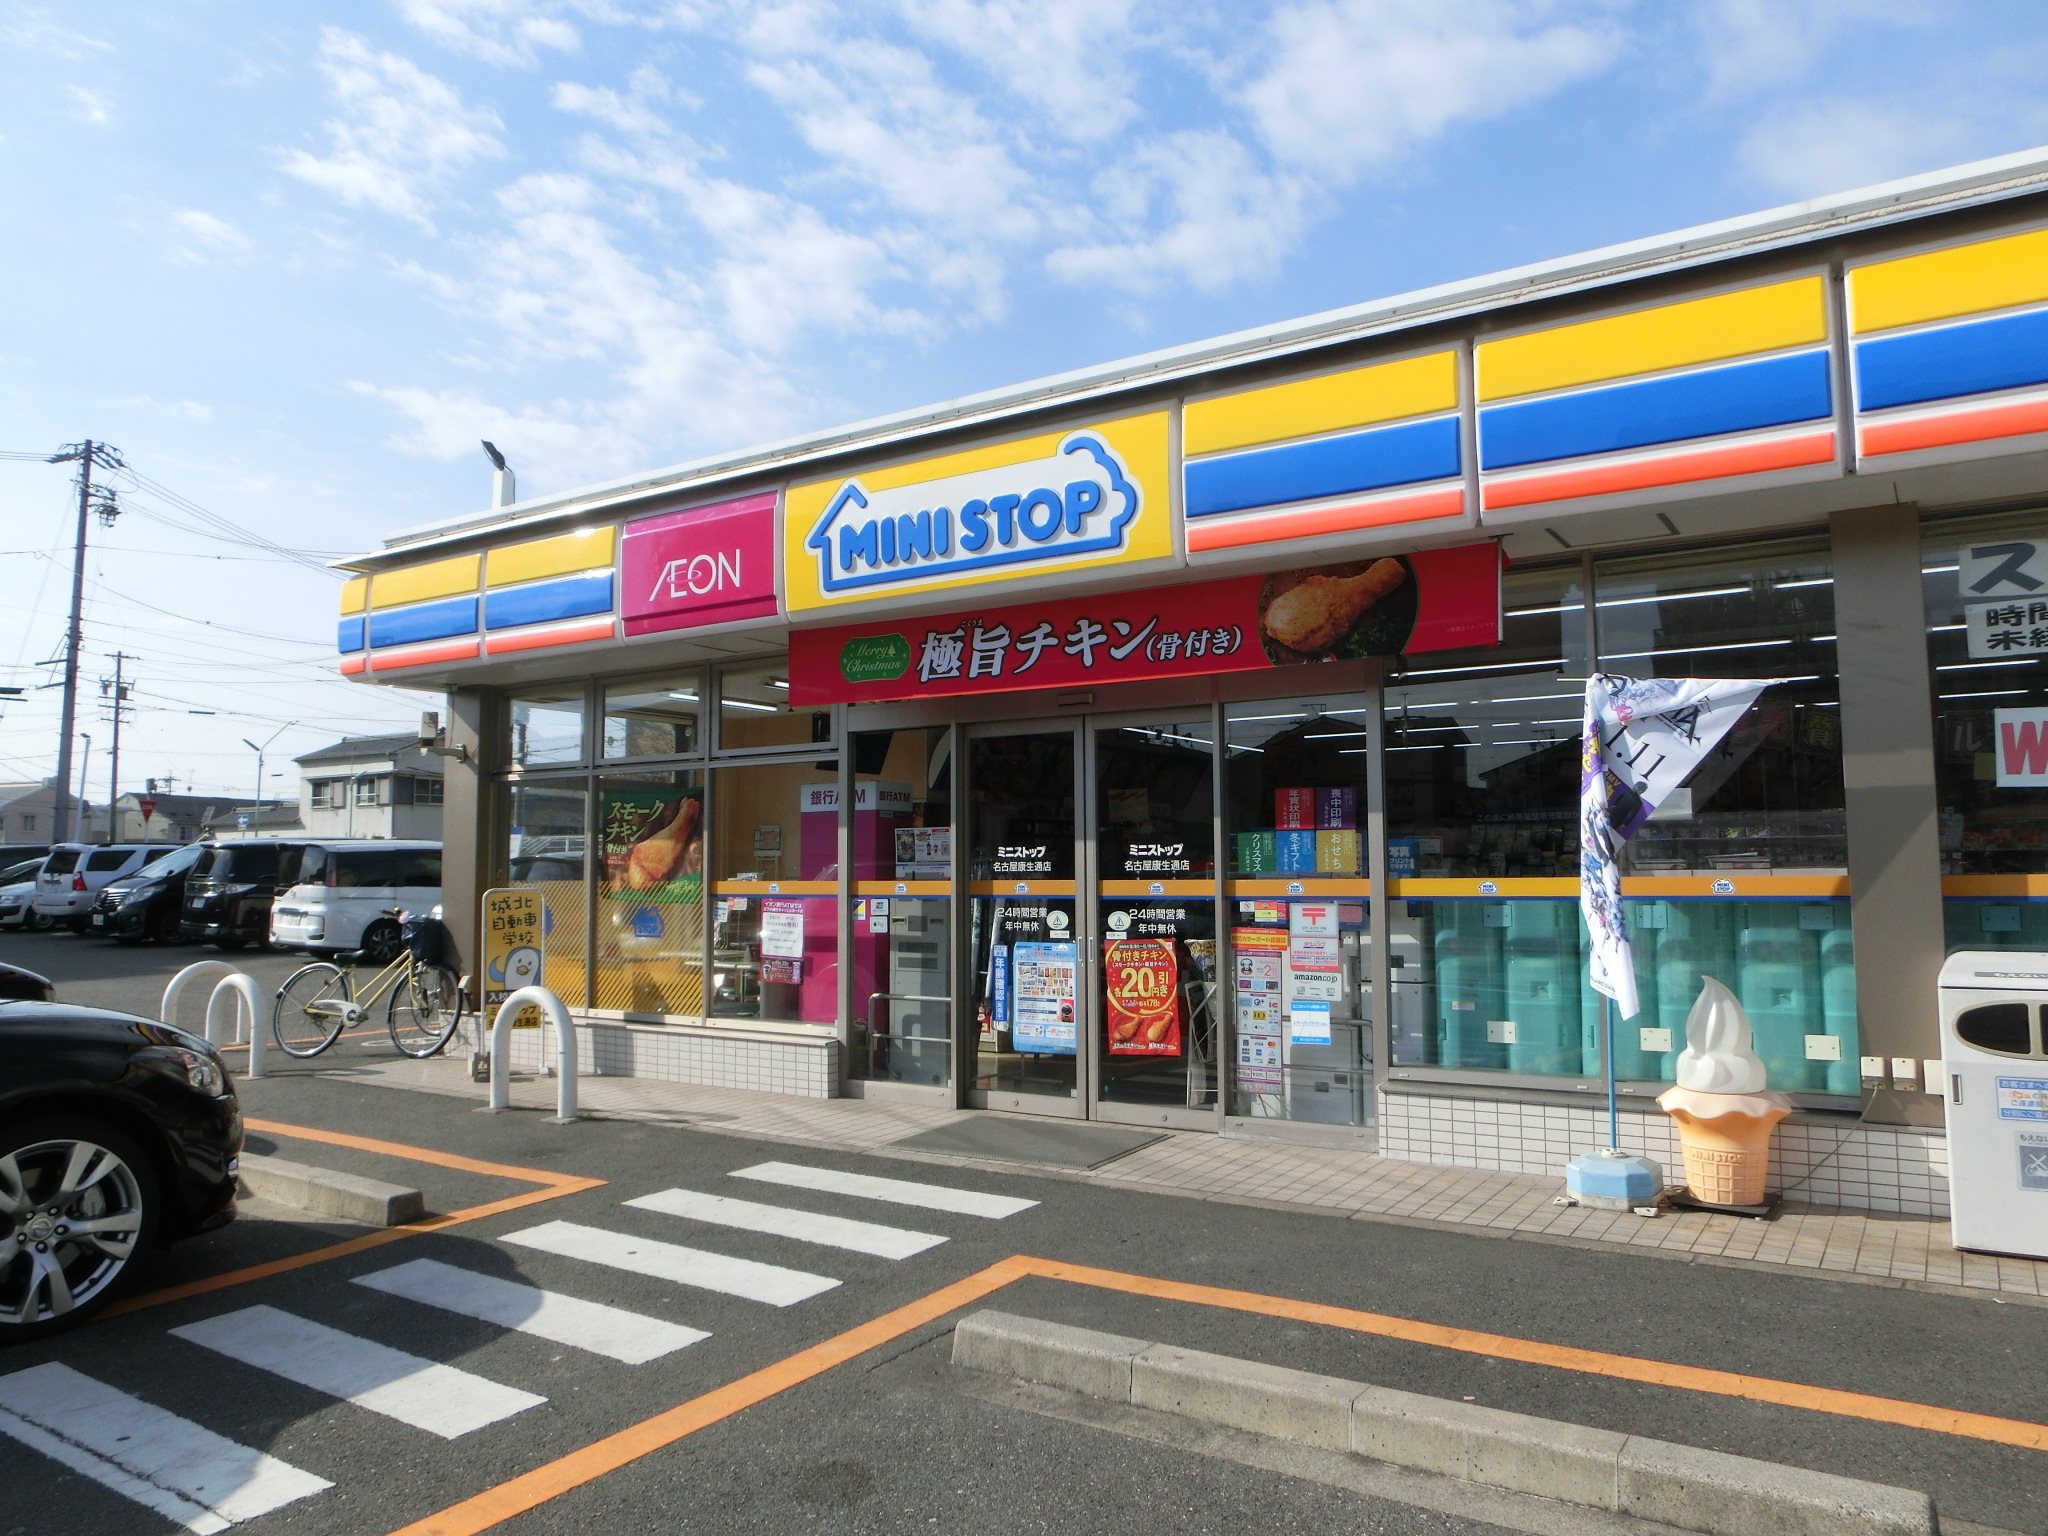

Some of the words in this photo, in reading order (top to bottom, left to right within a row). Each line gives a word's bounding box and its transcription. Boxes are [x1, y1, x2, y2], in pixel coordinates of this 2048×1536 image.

[840, 506, 949, 571] MINI
[960, 479, 1102, 551] STOP
[1969, 542, 2046, 595] ス
[960, 618, 983, 628] ごくうま
[850, 643, 889, 660] Merry
[846, 660, 901, 673] Christmas
[879, 789, 911, 803] 銀行ATM
[606, 799, 665, 823] スモーク
[1289, 789, 1301, 829] 年賀状印刷
[1330, 788, 1342, 828] 喪中印刷
[605, 823, 646, 843] チキン
[997, 845, 1047, 858] ミニストップ
[1129, 843, 1183, 856] ミニストップ
[1251, 833, 1262, 872] クリスマス
[1289, 832, 1301, 871] 冬ギフト
[1330, 832, 1342, 869] おせち
[993, 861, 1052, 872] 名古屋康生通店
[1124, 860, 1190, 871] 名古屋康生通店
[491, 896, 533, 914] 城北
[997, 907, 1048, 919] 24時間営業
[1129, 908, 1186, 920] 24時間営業
[493, 912, 537, 932] 自動車
[1005, 921, 1040, 932] 年中無休
[1138, 923, 1177, 935] 年中無休
[503, 932, 534, 947] 学校
[1112, 950, 1167, 962] 骨付きチキン
